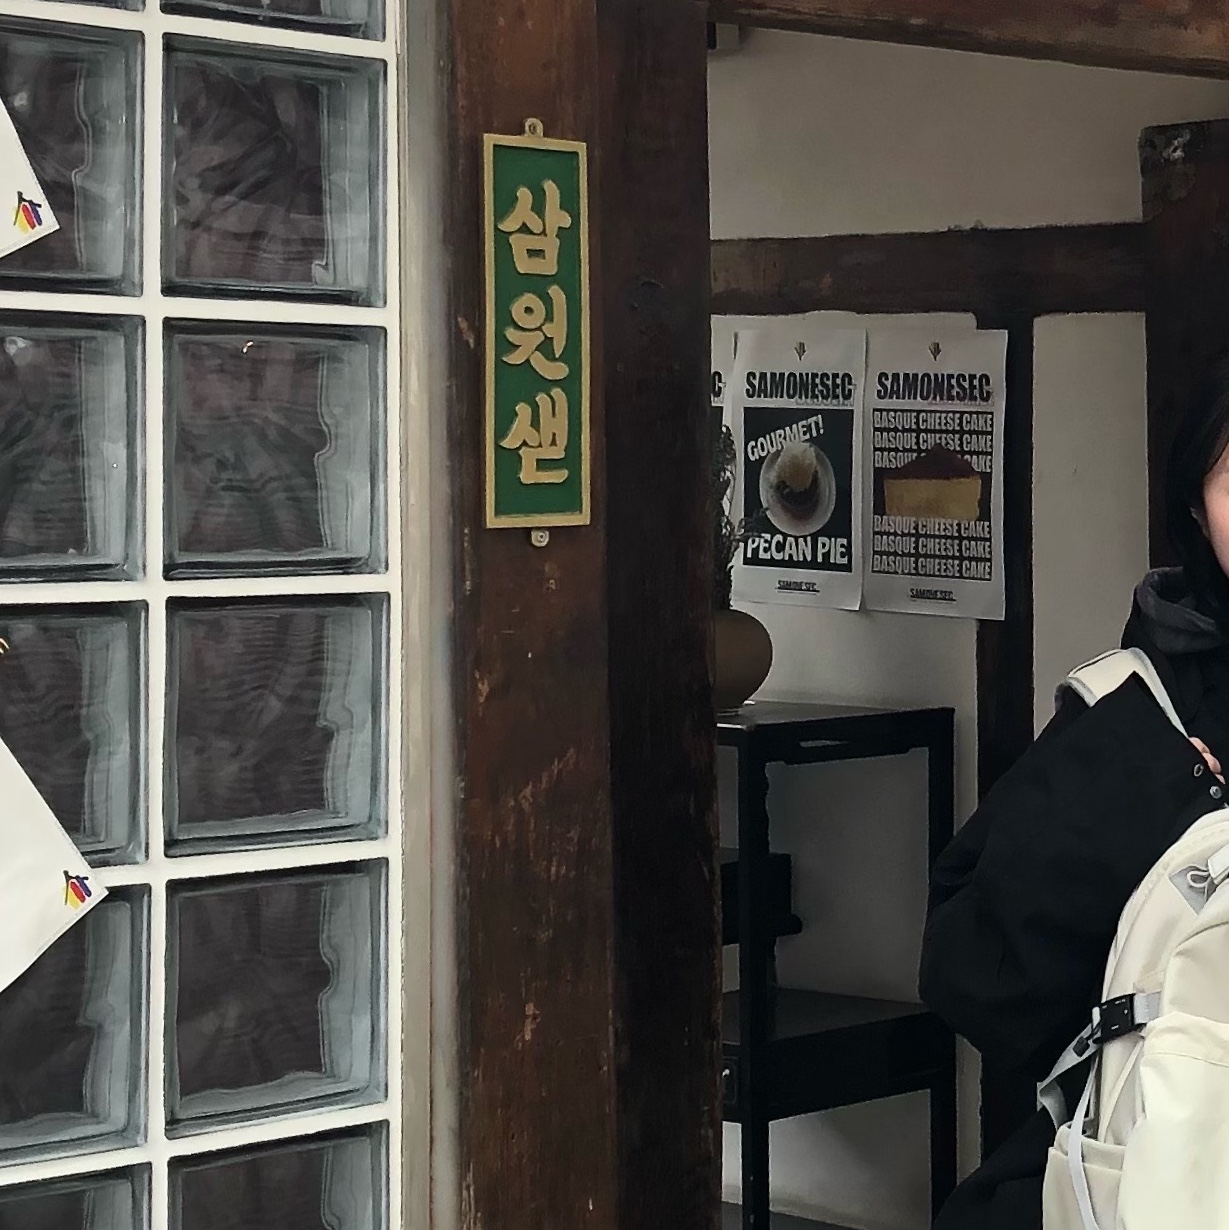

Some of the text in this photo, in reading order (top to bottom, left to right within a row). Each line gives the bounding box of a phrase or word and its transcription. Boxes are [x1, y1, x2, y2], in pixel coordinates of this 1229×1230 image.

[745, 371, 853, 401] SAMONESEC
[876, 371, 991, 402] SAMONESEC
[873, 411, 992, 432] BASQUE CHEESE CAKE
[747, 414, 824, 461] GOURMET!
[874, 431, 917, 450] BASQUE
[962, 434, 992, 452] CAKE
[873, 514, 990, 538] BASQUE CHEESE CAKE
[746, 533, 848, 564] PECAN PIE
[873, 534, 991, 559] BASQUE CHEESE CAKE
[873, 554, 991, 579] BASQUE CHEESE CAKE
